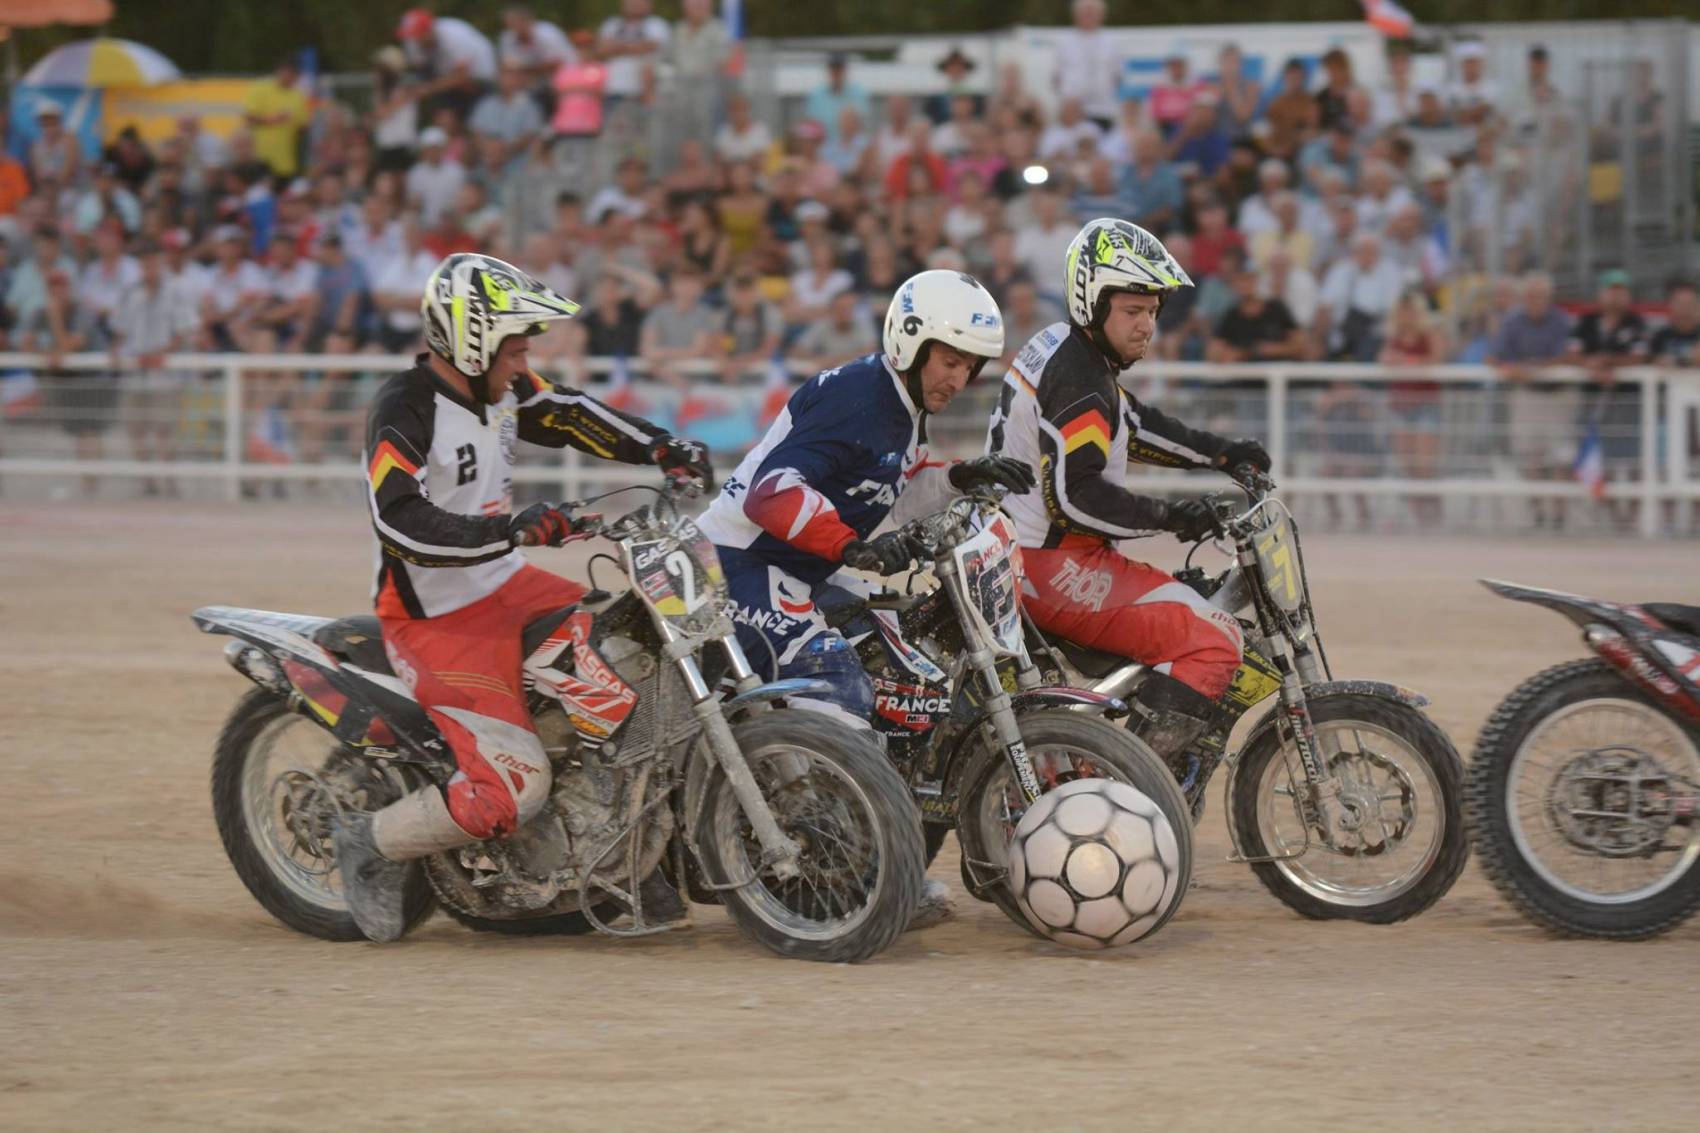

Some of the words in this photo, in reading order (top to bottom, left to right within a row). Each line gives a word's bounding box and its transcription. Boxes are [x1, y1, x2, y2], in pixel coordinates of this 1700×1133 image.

[903, 314, 924, 337] 6
[456, 443, 477, 486] 2
[664, 549, 709, 616] 2
[1049, 557, 1113, 613] THOR
[1271, 543, 1297, 600] 7
[723, 598, 797, 636] RANCE
[875, 695, 952, 713] FRANCE
[494, 751, 541, 776] thor
